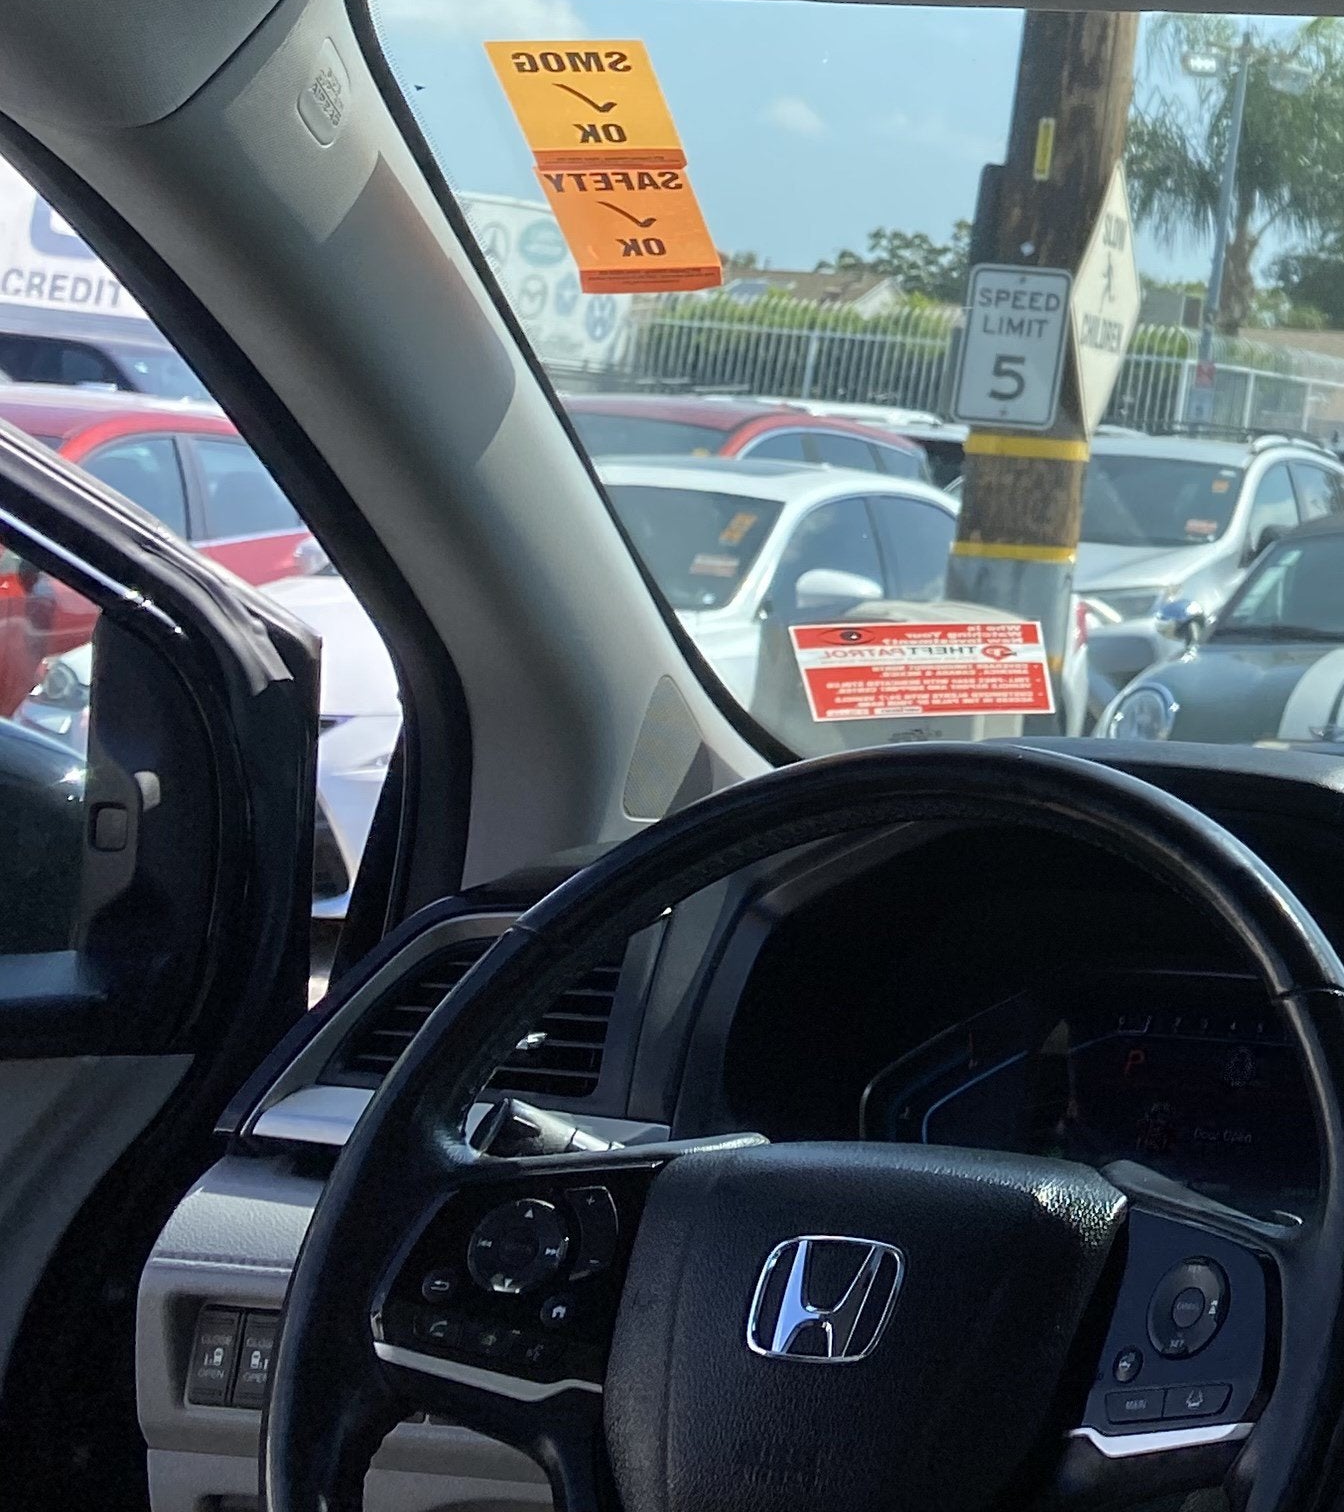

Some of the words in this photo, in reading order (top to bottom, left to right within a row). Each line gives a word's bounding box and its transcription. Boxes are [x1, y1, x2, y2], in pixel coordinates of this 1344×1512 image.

[1, 267, 123, 309] CREDIT
[978, 287, 1061, 312] SPEED
[982, 316, 1049, 338] LIMIT
[988, 353, 1026, 401] 5
